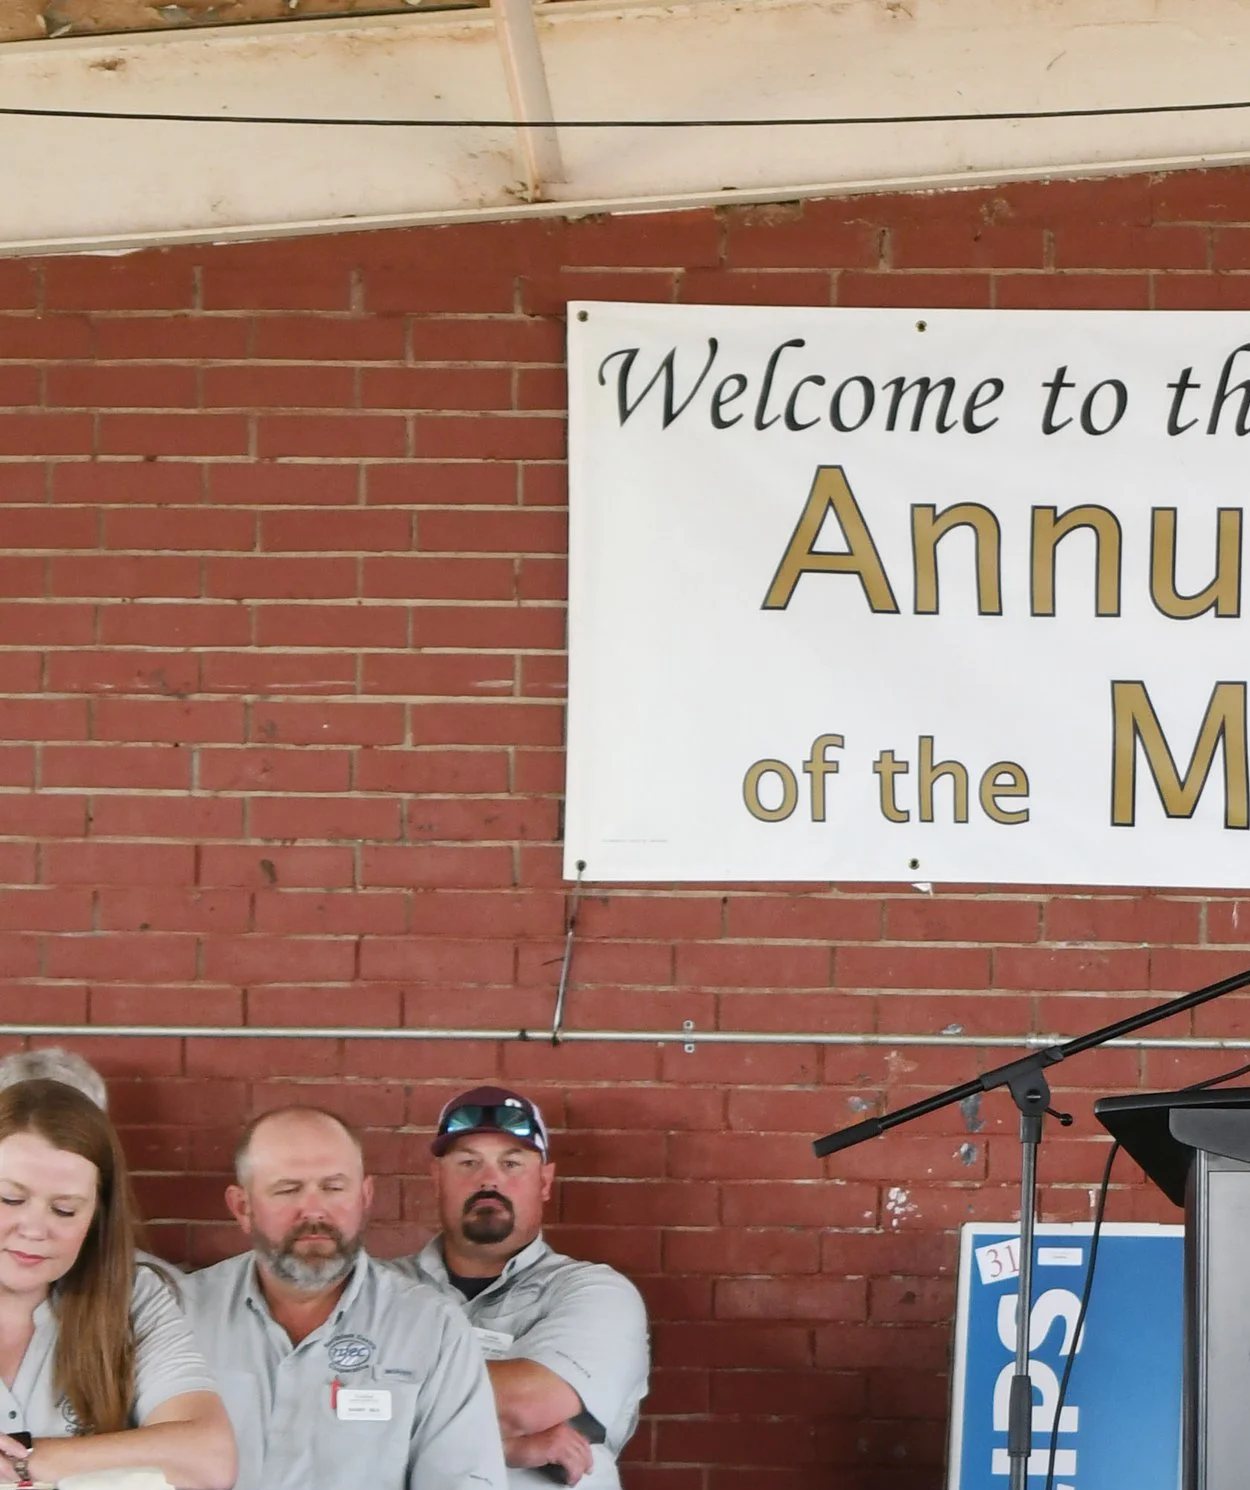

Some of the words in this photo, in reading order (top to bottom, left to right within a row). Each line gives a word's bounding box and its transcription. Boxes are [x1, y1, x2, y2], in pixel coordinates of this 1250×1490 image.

[598, 337, 1004, 434] Welcome
[1041, 365, 1128, 436] to
[742, 733, 844, 823] of
[872, 736, 1030, 825] the
[986, 1247, 1019, 1279] 31
